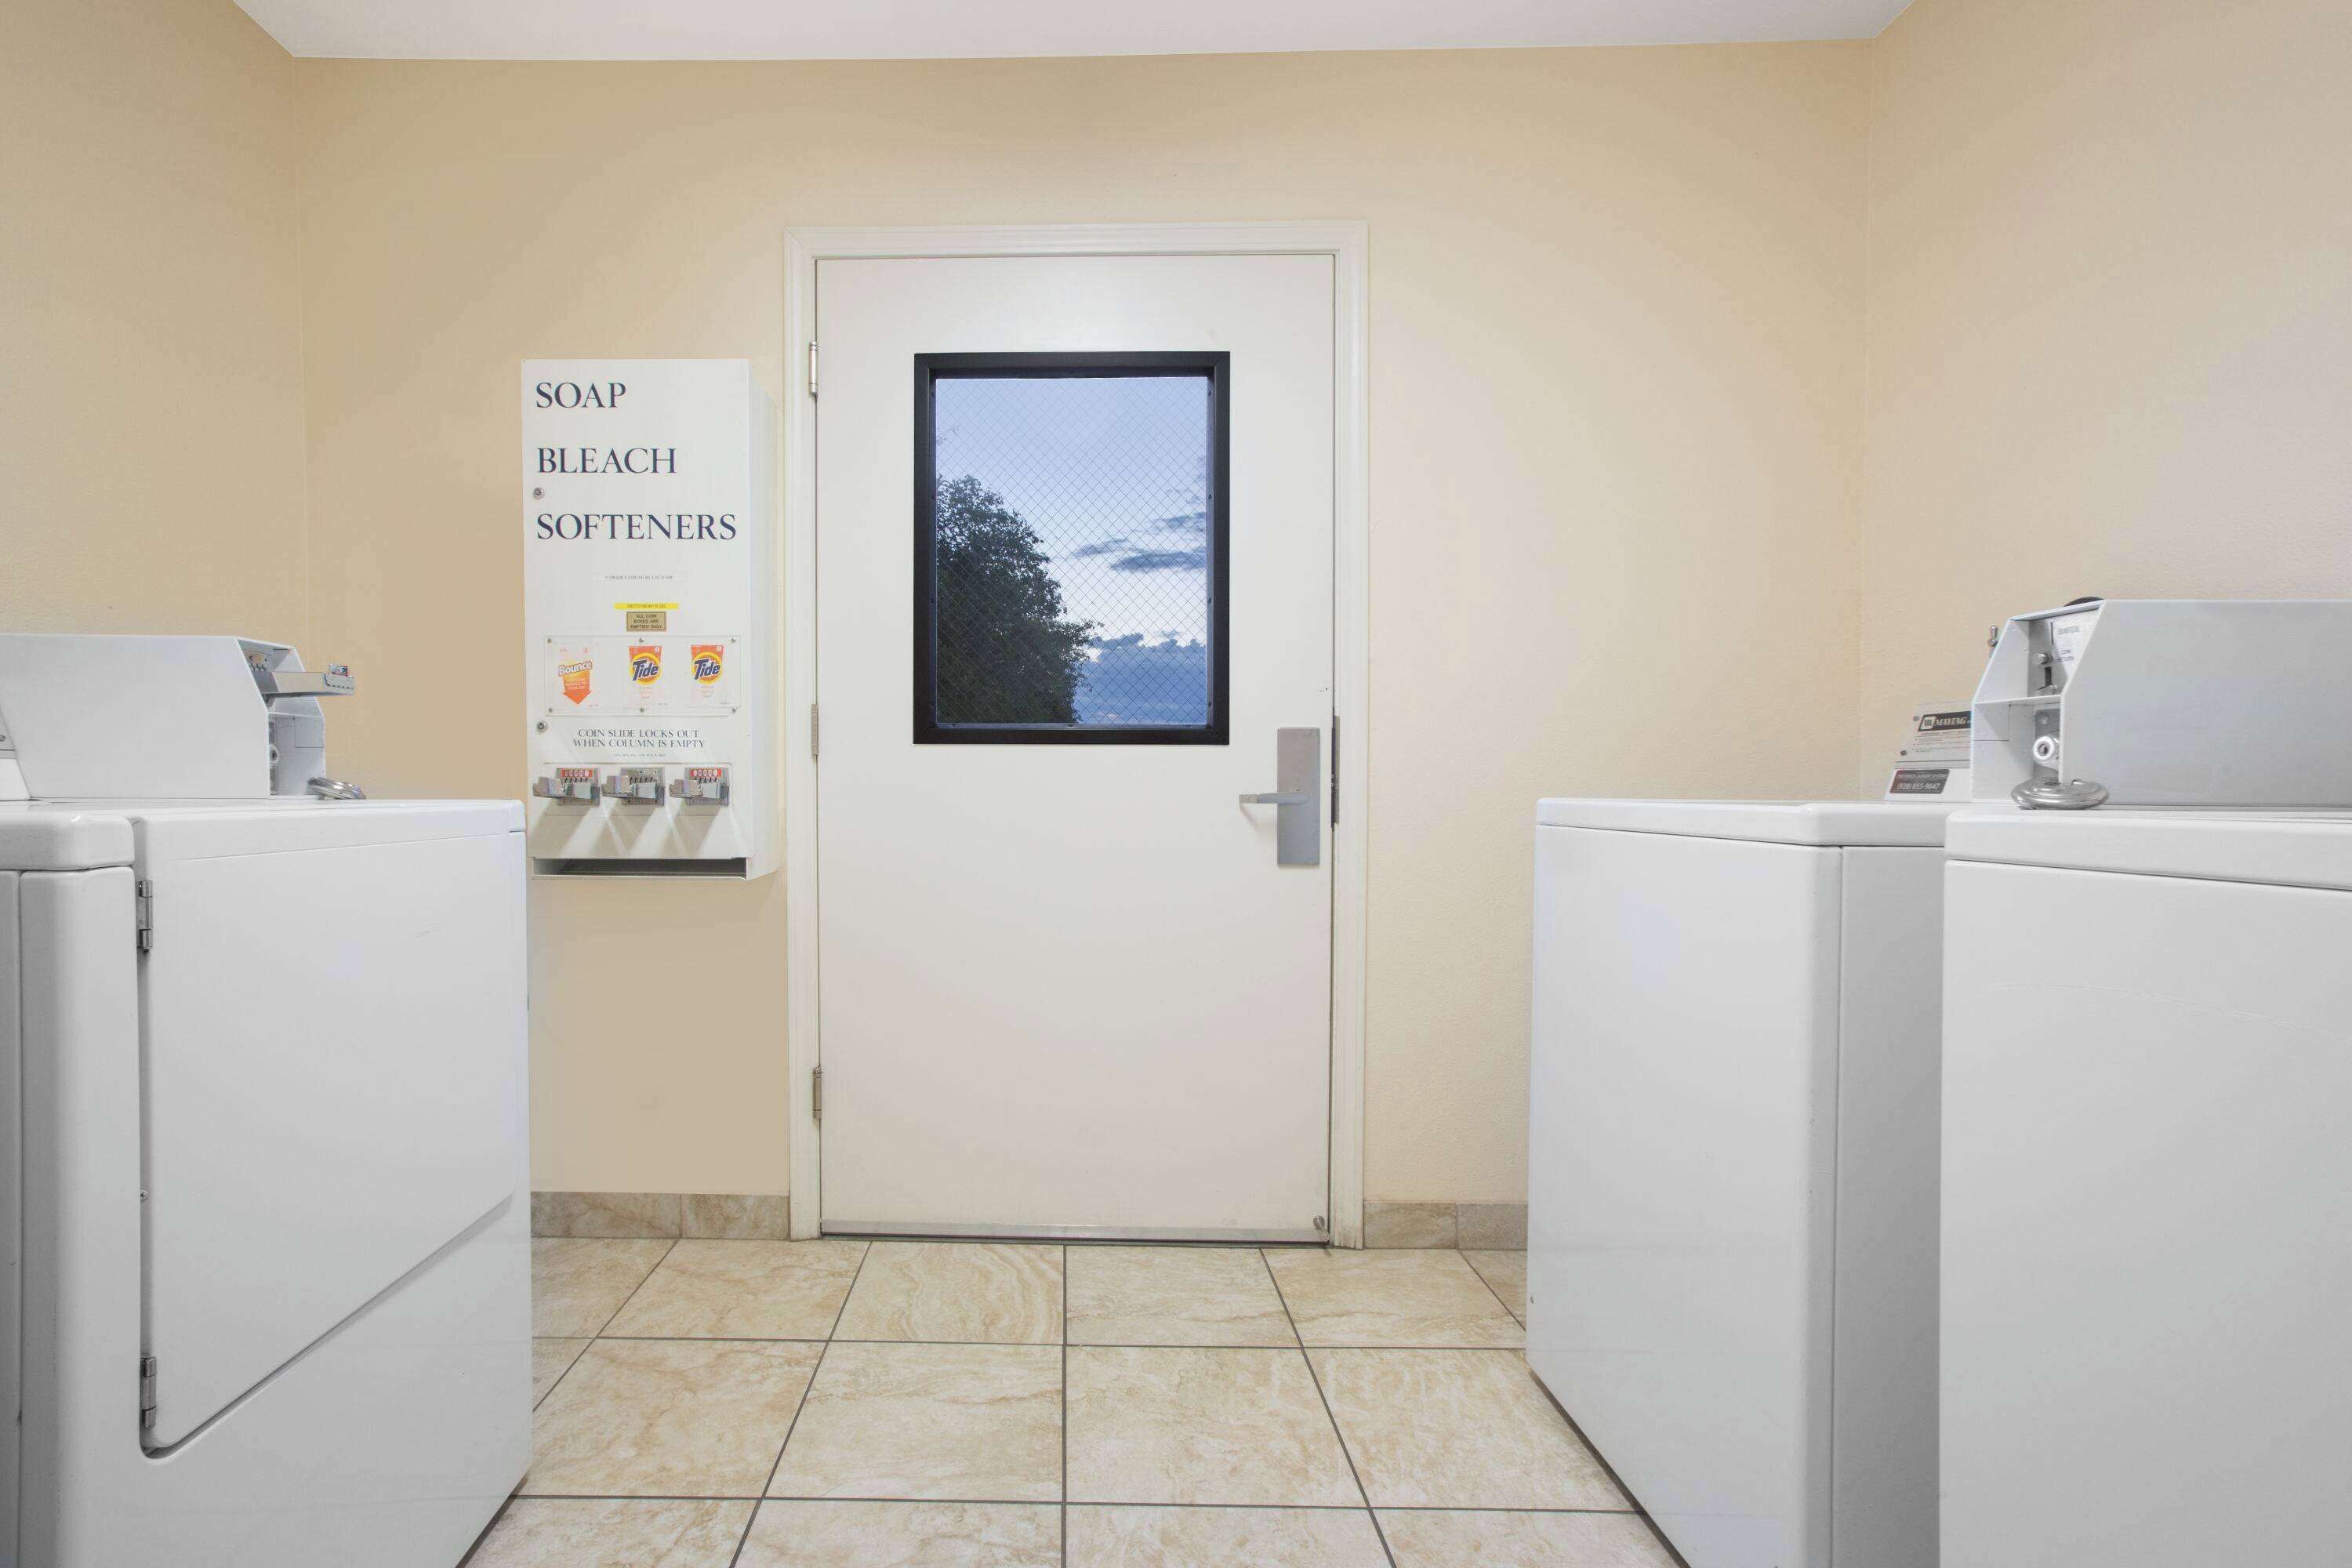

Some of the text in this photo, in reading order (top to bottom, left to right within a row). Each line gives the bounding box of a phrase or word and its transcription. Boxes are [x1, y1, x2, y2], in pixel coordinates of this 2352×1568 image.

[535, 382, 626, 408] SOAP
[537, 448, 677, 474] BLEACH
[536, 514, 736, 540] SOFTENERS
[557, 660, 593, 677] Bounce
[632, 659, 659, 681] Tide
[694, 659, 720, 680] Tide
[573, 739, 705, 748] WHEN COLUMN IS EMPTY
[578, 729, 700, 738] COIN SLIDE LOCKS OUT
